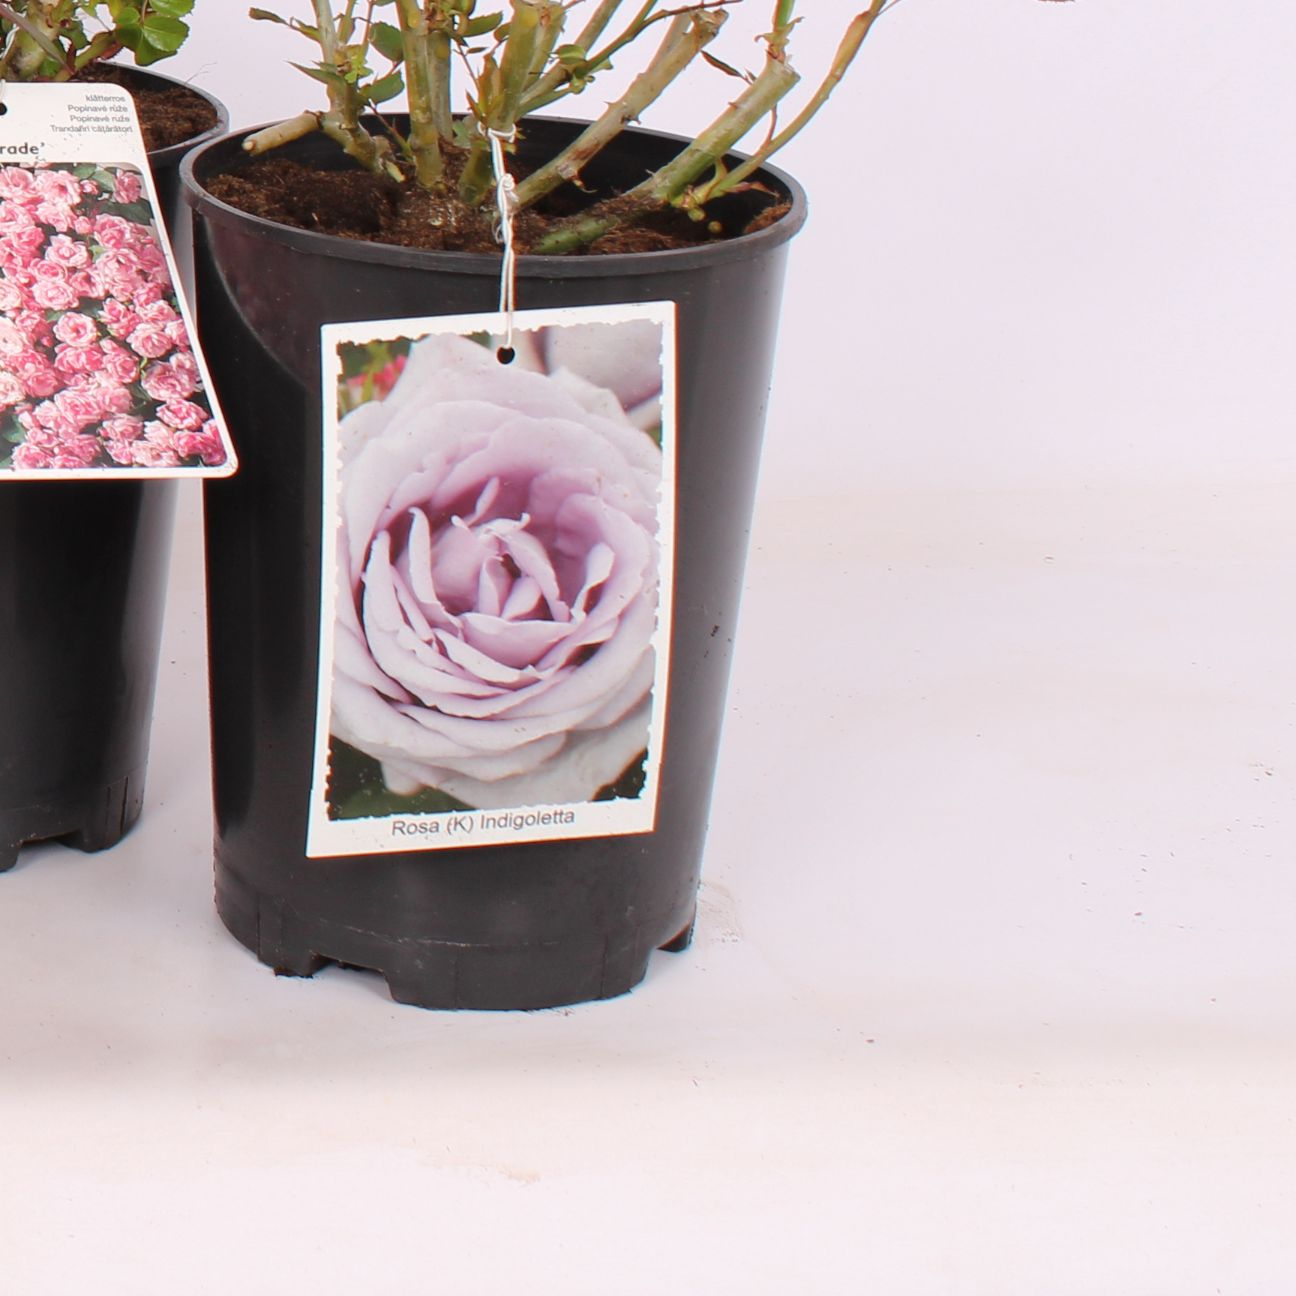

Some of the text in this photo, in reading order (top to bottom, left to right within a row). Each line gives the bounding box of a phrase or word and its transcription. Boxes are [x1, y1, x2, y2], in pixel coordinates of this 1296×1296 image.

[391, 809, 575, 836] Rosa (K) Indigoletta
